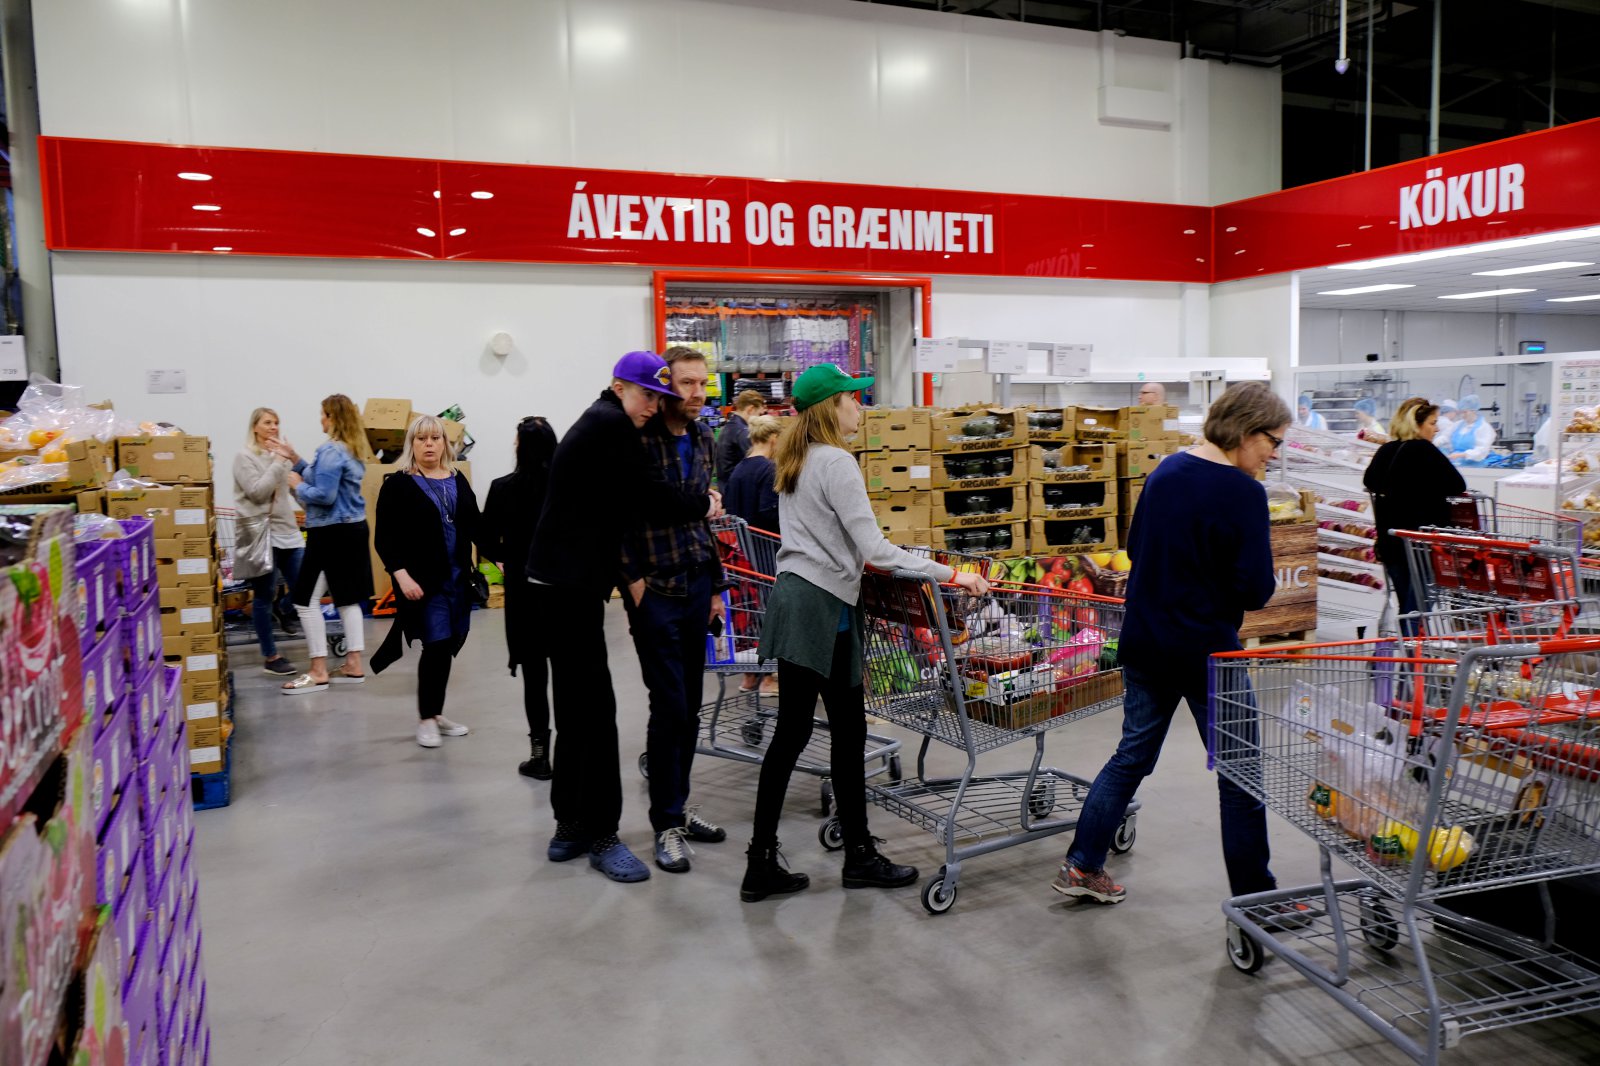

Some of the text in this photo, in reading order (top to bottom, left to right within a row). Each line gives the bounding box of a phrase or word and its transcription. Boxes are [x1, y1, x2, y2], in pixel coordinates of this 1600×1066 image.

[1399, 163, 1525, 231] KÖKUR
[567, 181, 994, 254] ÁVEXTIR OG GRÆNMETI
[961, 440, 1002, 451] ORGANIC
[1055, 472, 1092, 482] ORGANIC
[960, 479, 1001, 489] ORGANIC
[1056, 508, 1094, 518] ORGANIC
[960, 515, 1001, 526] ORGANIC
[1057, 545, 1095, 555] ORGANIC
[1274, 565, 1309, 589] NIC
